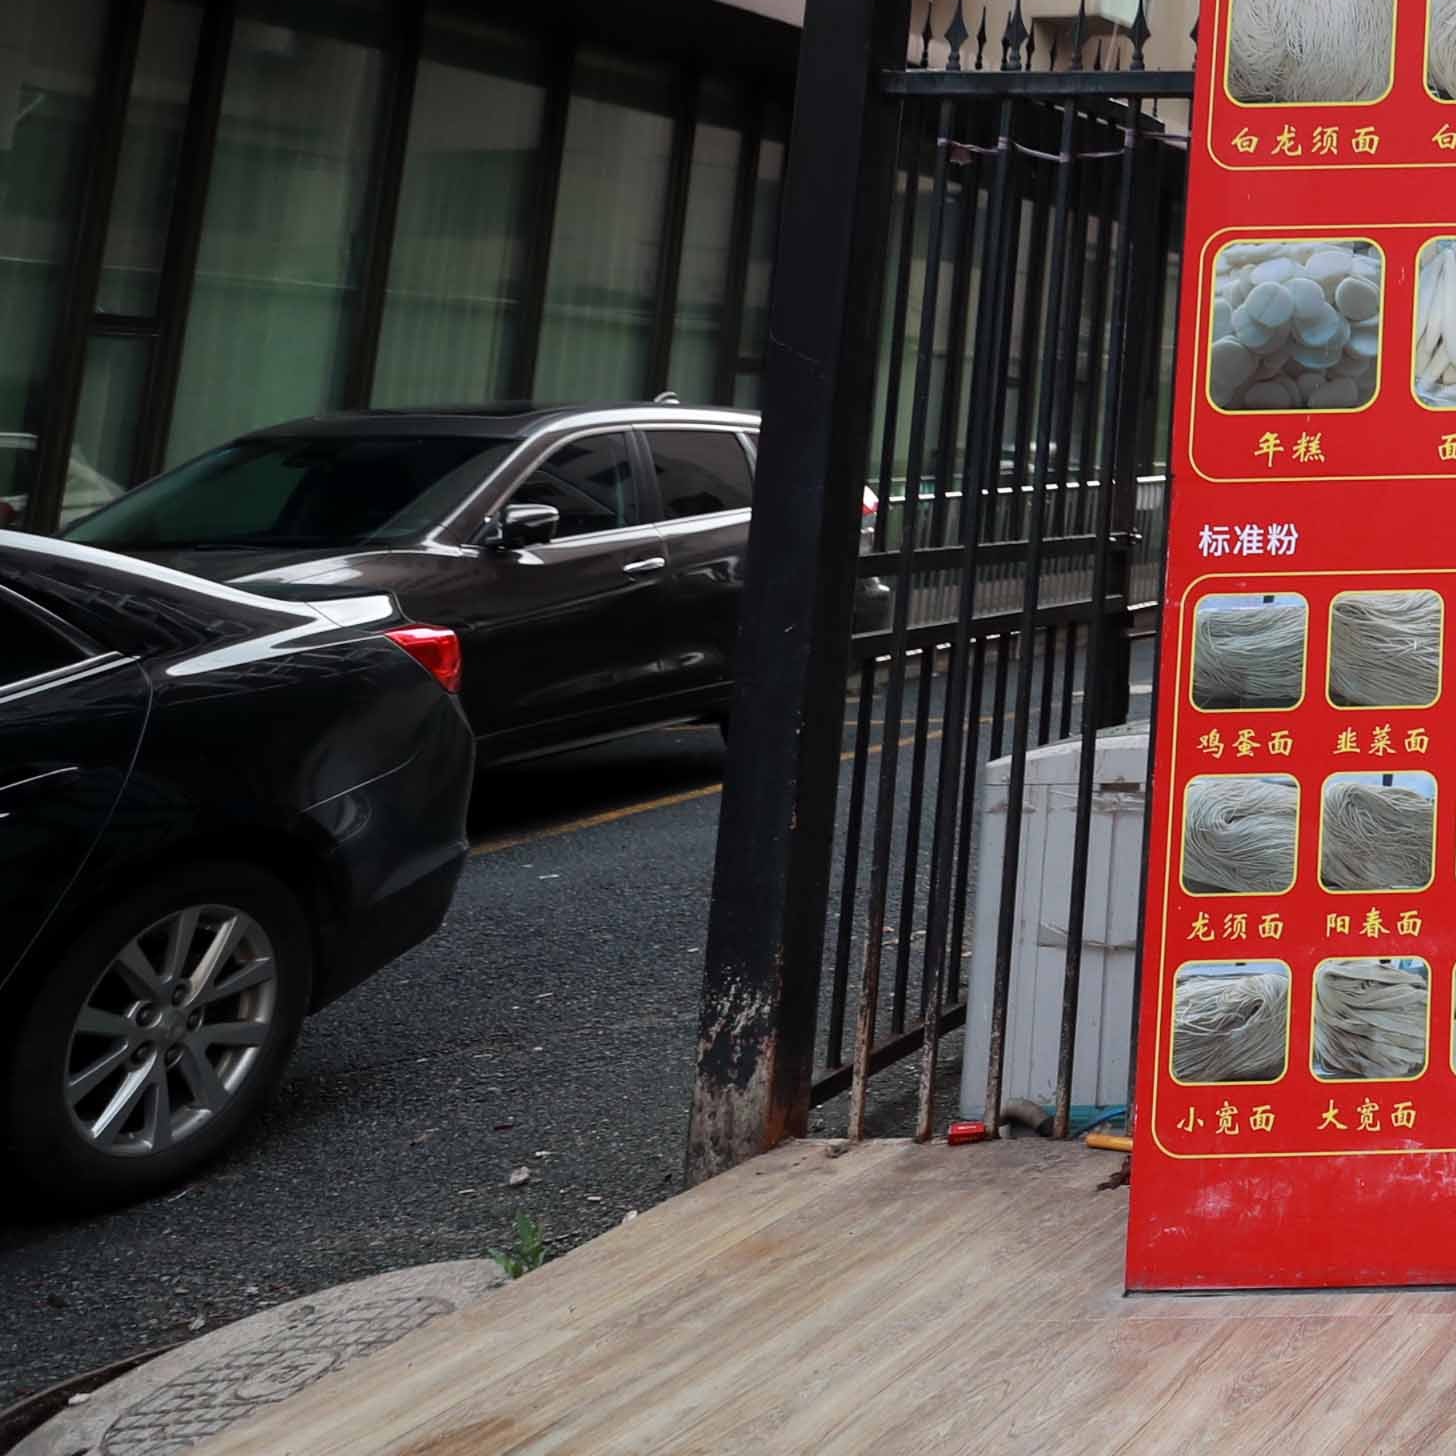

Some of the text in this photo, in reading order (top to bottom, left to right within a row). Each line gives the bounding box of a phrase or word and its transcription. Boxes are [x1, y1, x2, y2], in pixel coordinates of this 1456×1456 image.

[1232, 125, 1379, 156] 白龙须面
[1254, 432, 1324, 467] 年糕
[1199, 523, 1298, 556] 标准粉
[1198, 729, 1292, 758] 鸡蛋面
[1334, 724, 1428, 756] 韭菜面
[1188, 912, 1283, 941] 龙须面
[1327, 907, 1421, 938] 阳春面
[1177, 1101, 1274, 1134] 小宽面
[1318, 1098, 1416, 1131] 大宽面
